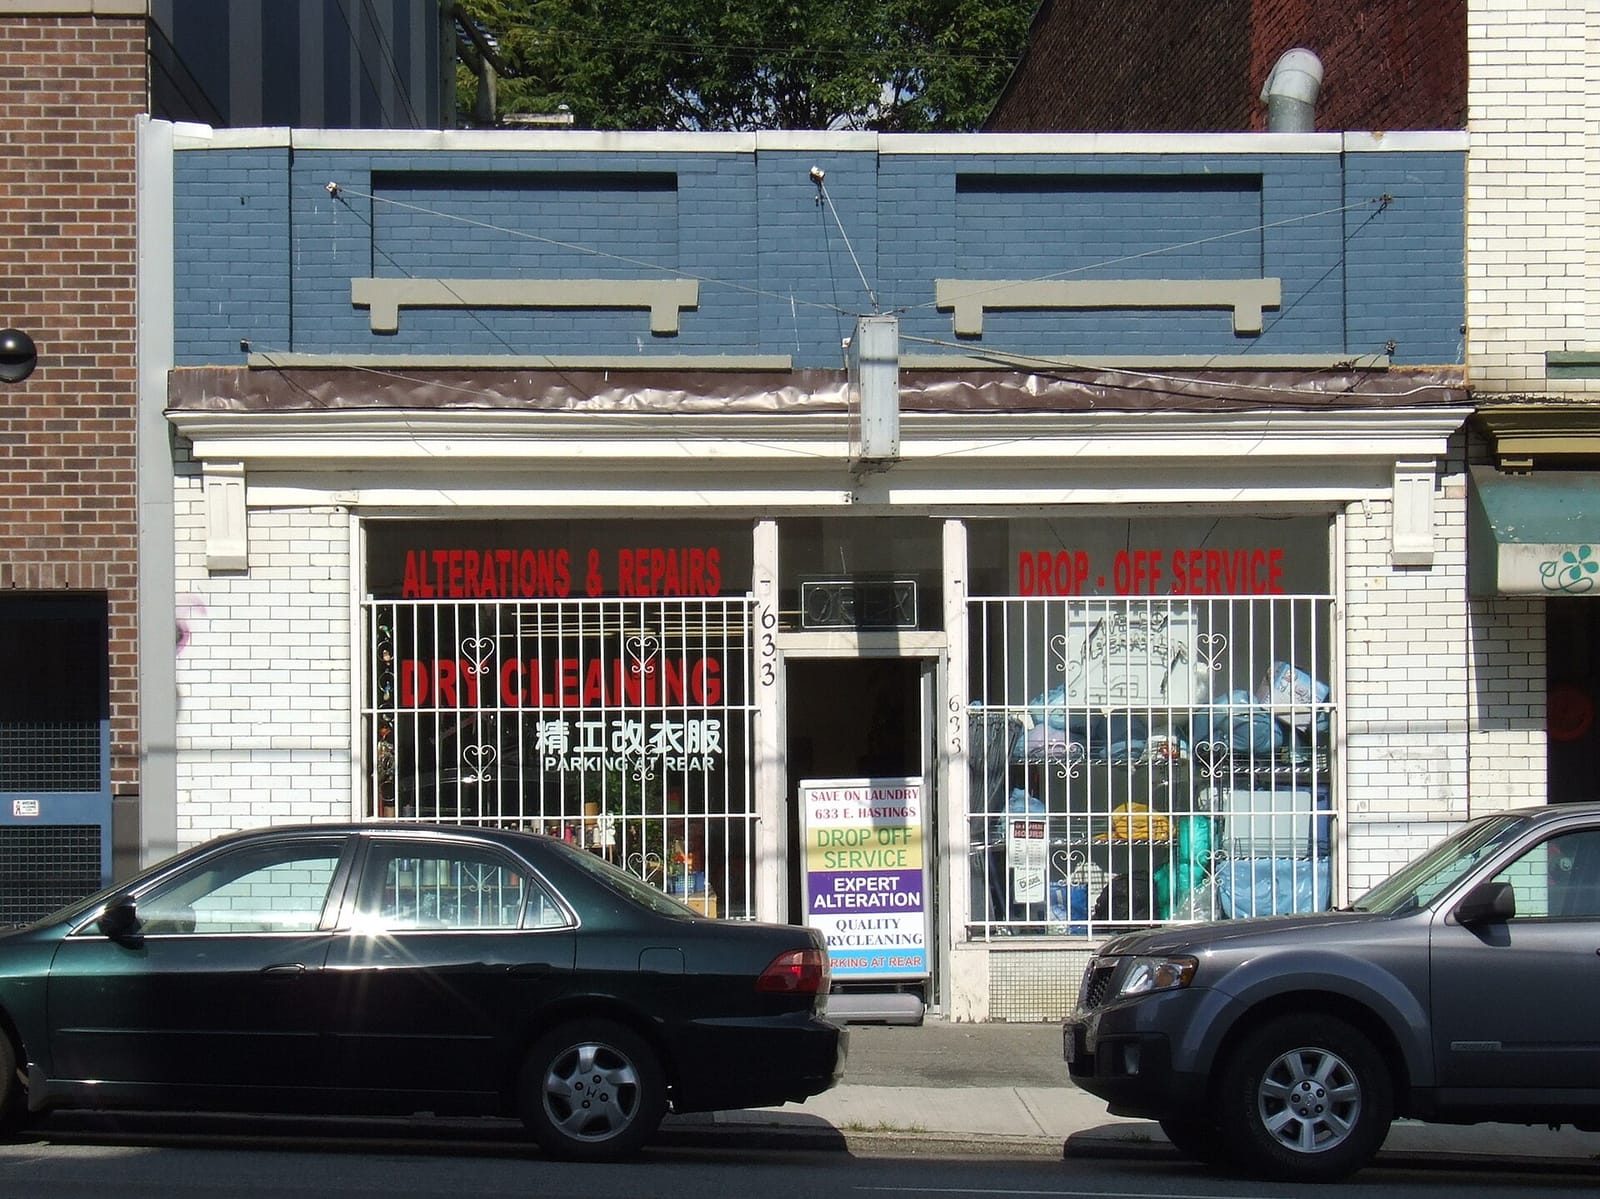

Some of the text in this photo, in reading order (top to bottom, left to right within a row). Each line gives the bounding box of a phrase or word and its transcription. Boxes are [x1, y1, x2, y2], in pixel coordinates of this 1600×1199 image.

[403, 548, 721, 598] ALTERATIONS & REPAIRS
[1018, 550, 1090, 597] DROP
[1113, 550, 1163, 596] OFF
[1171, 548, 1284, 596] SERVICE
[761, 604, 776, 686] 633
[402, 658, 721, 707] DRY CLEANING
[535, 719, 722, 754] 精工改衣服
[544, 756, 629, 772] PARKING
[665, 756, 715, 772] REAR
[811, 788, 919, 802] SAVE ON LAUNDRY
[815, 806, 917, 820] 633 E. HASTINGS
[817, 827, 913, 848] DROP OFF
[824, 849, 908, 869] SERVICE
[834, 876, 900, 892] EXPERT
[813, 891, 921, 909] ALTERATION
[835, 918, 901, 932] QUALITY
[826, 933, 923, 946] RYCLEANING
[830, 956, 922, 968] RKING AT REAR
